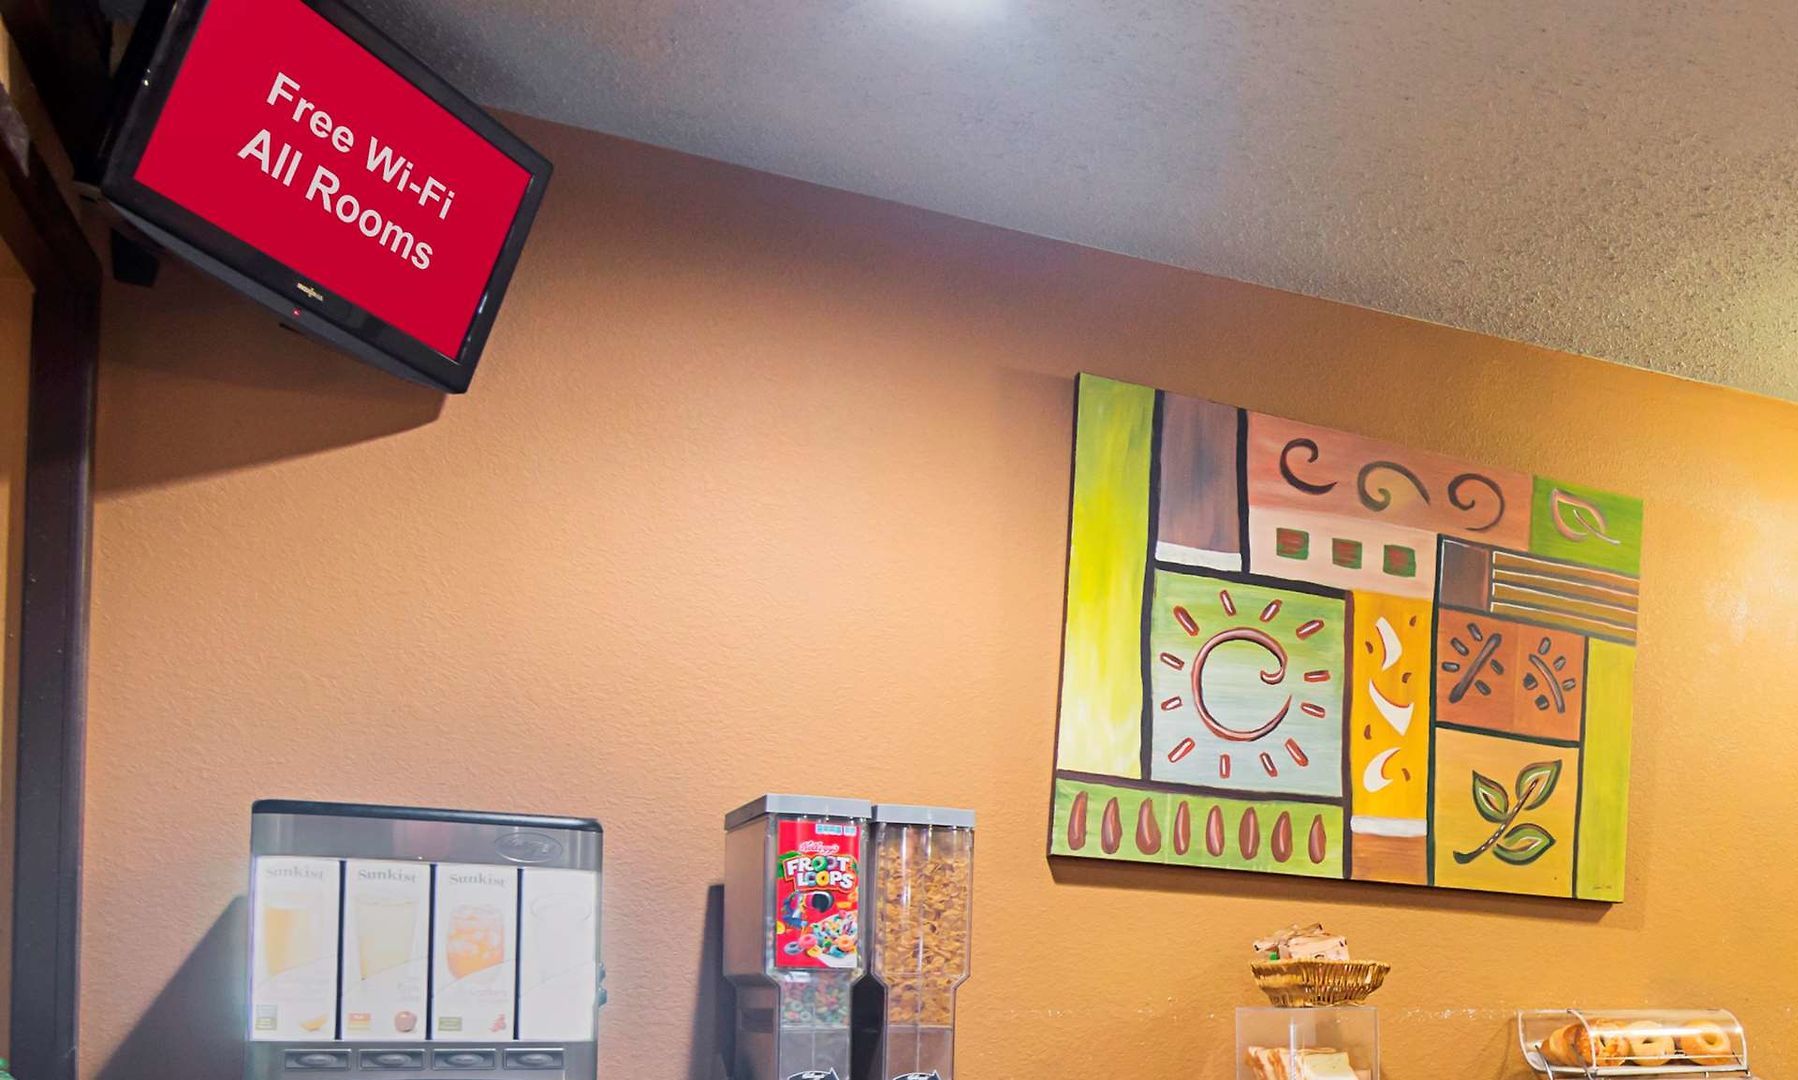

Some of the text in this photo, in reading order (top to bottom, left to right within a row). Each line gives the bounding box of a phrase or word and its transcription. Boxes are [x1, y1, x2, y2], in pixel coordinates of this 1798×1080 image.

[237, 129, 434, 271] All Rooms
[266, 71, 455, 220] Free Wi-Fi
